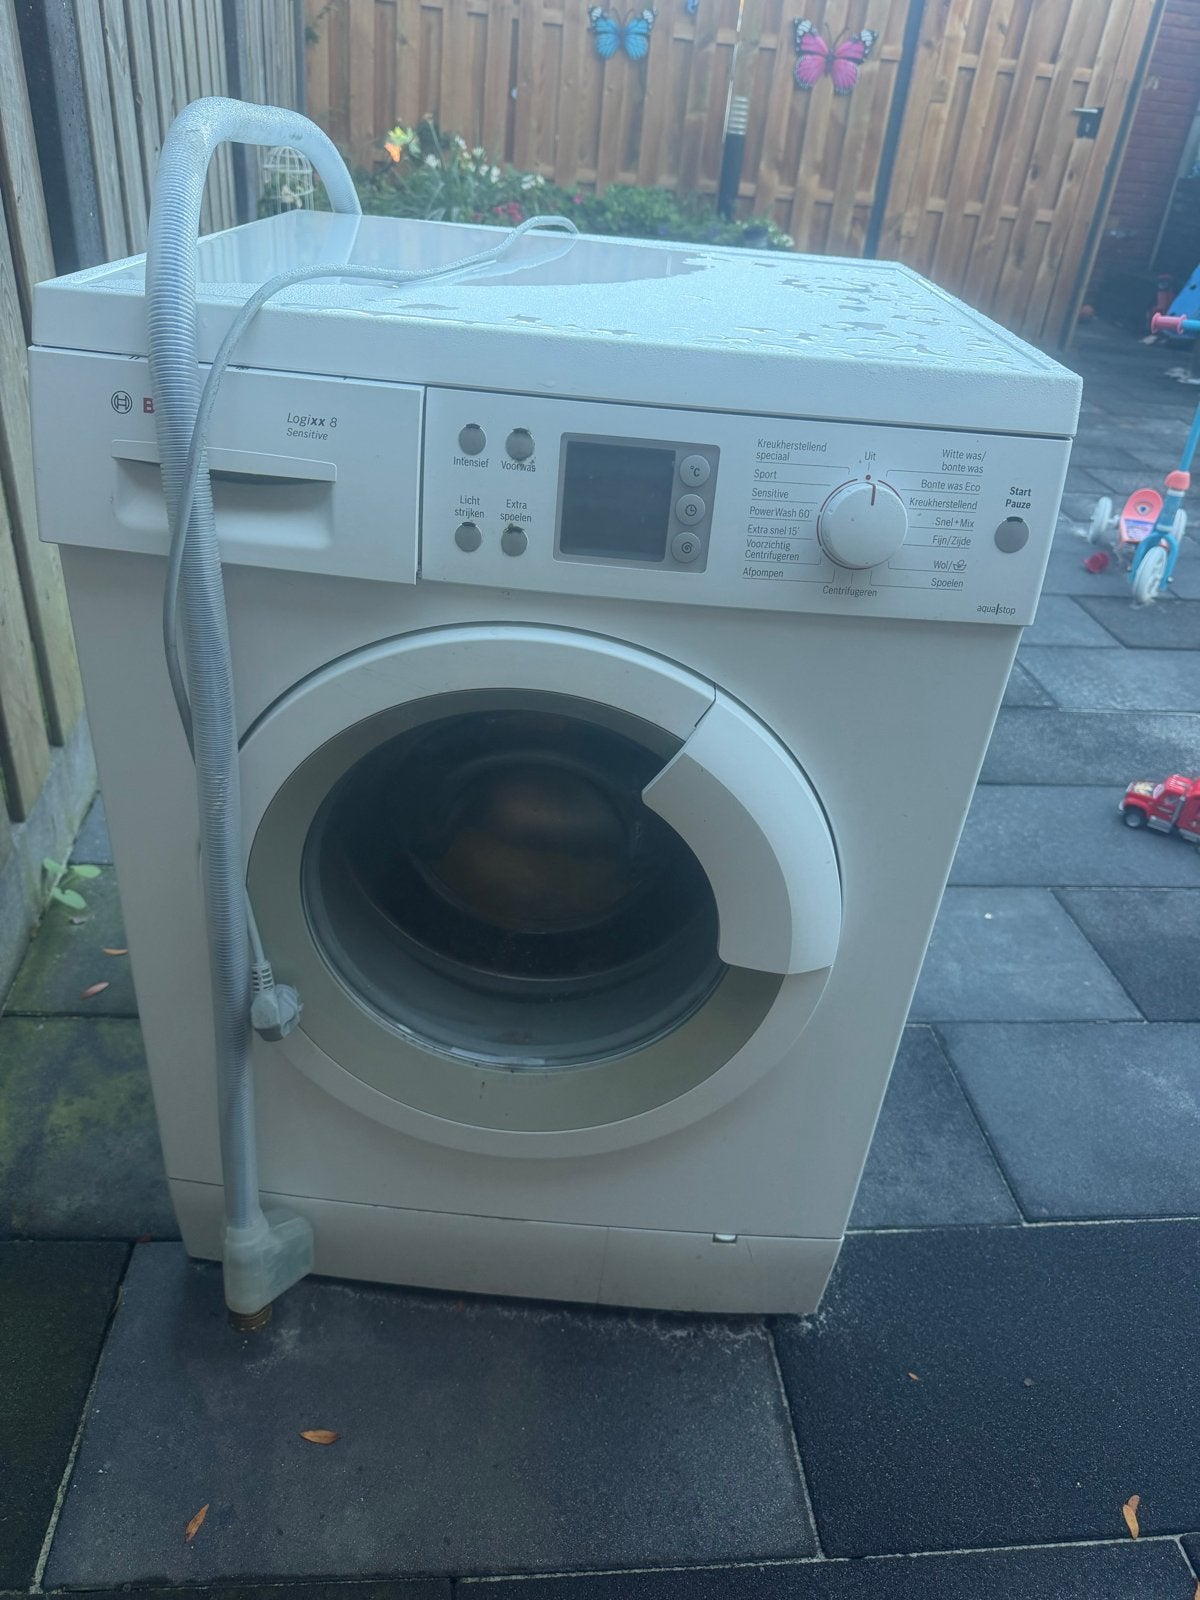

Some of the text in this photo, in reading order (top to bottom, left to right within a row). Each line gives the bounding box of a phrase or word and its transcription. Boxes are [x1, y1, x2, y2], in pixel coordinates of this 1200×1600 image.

[287, 412, 338, 428] Logixx 8
[286, 427, 329, 441] Sensitive
[757, 439, 828, 453] Kreukherstellend
[755, 451, 791, 462] speciaal
[864, 451, 876, 461] Uit
[942, 448, 987, 462] Witte was/
[453, 456, 489, 468] Intensief
[501, 460, 536, 473] Voorwas
[941, 461, 984, 474] bonte was
[753, 468, 777, 480] Sport
[921, 479, 981, 493] Bonte was Eco
[1009, 486, 1032, 497] Start
[751, 487, 789, 499] Sensitive
[459, 495, 480, 506] Licht
[506, 498, 528, 510] Extra
[909, 496, 978, 511] Kreukherstellend
[1005, 498, 1032, 510] Pauze
[454, 507, 485, 519] strijken
[500, 511, 532, 523] spoelen
[747, 523, 769, 534] Extra
[770, 525, 787, 536] snel
[746, 538, 791, 552] Voorzichtig
[932, 534, 972, 547] Fijn/Zijde
[744, 549, 800, 562] Centrifugeren
[742, 567, 784, 578] Afpompen
[930, 577, 964, 588] Spoelen
[822, 585, 878, 598] Centrifugeren
